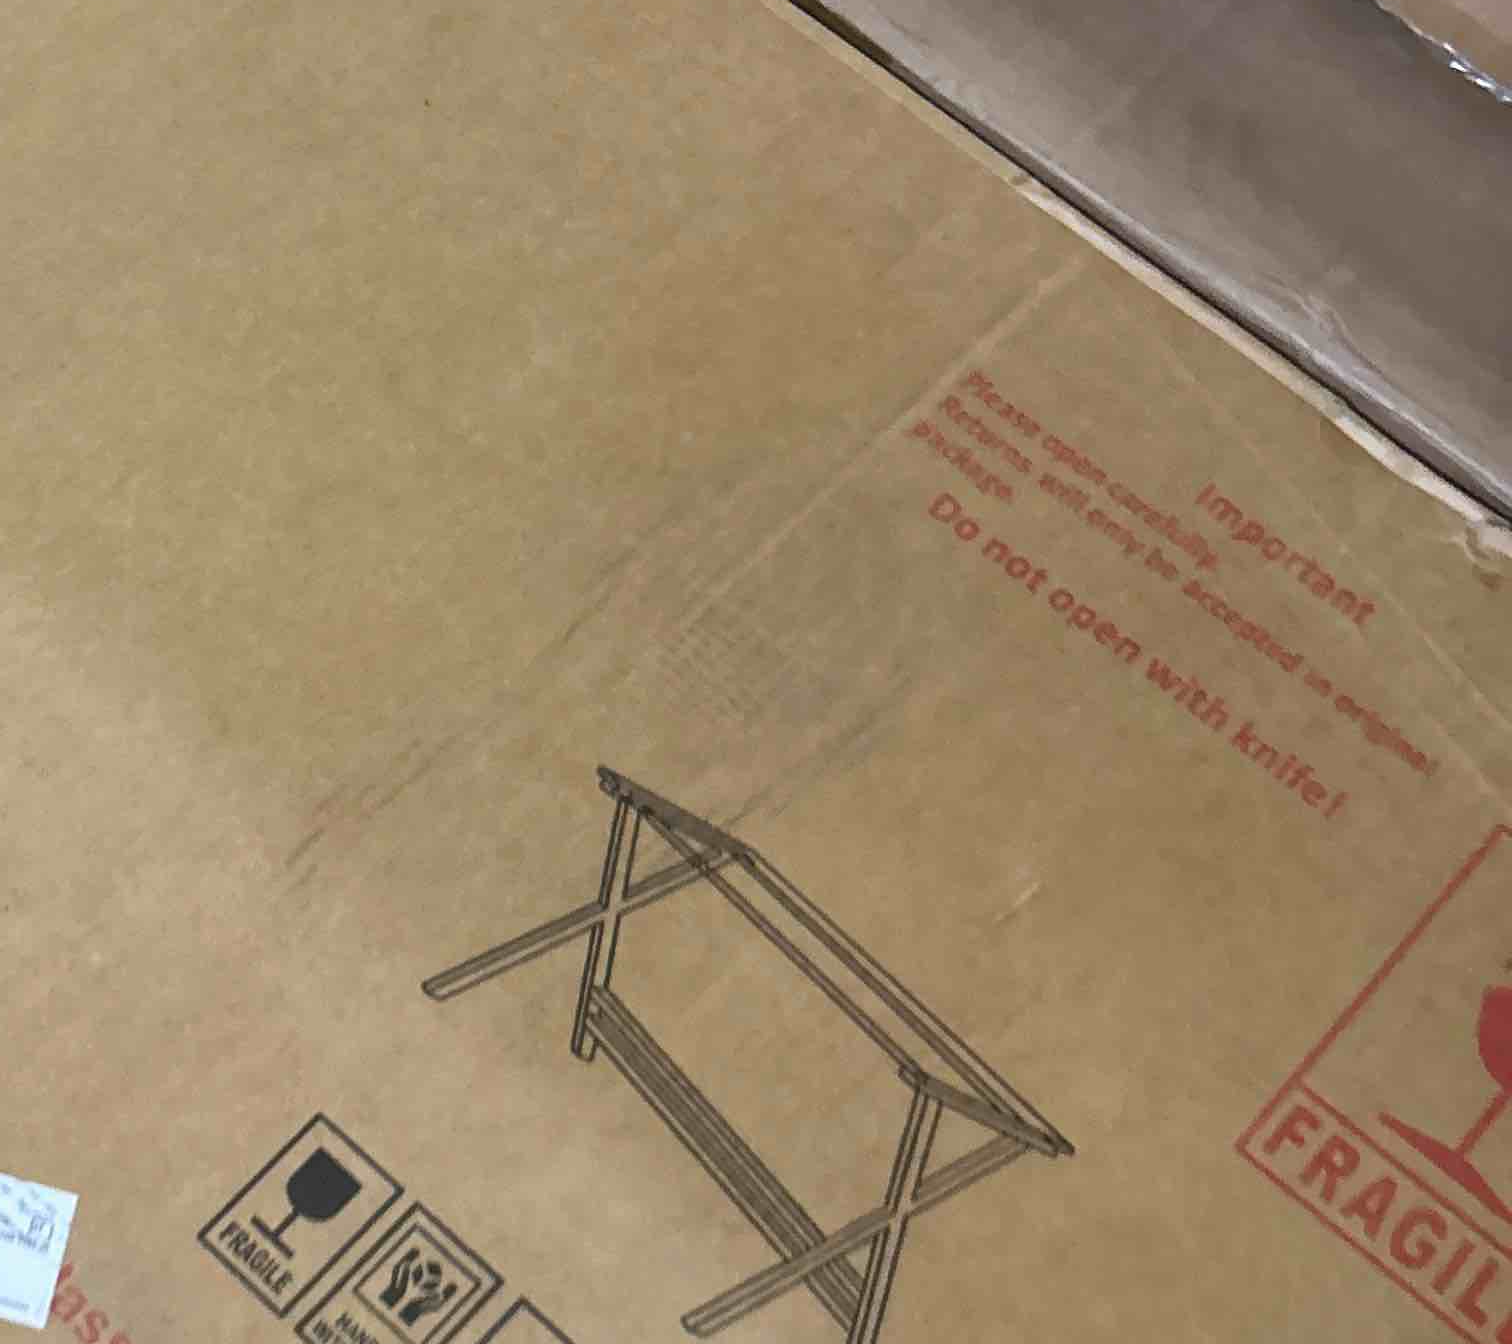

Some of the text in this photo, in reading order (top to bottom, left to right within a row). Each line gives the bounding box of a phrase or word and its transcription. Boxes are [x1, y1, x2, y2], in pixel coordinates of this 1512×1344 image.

[966, 368, 1222, 574] Please open carefully
[927, 490, 981, 543] Do
[980, 536, 1049, 596] not
[1047, 586, 1145, 666] open
[1144, 656, 1231, 733] with
[1144, 546, 1180, 581] be
[1182, 578, 1304, 676] accepted
[1195, 480, 1377, 630] Important
[218, 1220, 294, 1297] FRAGILE
